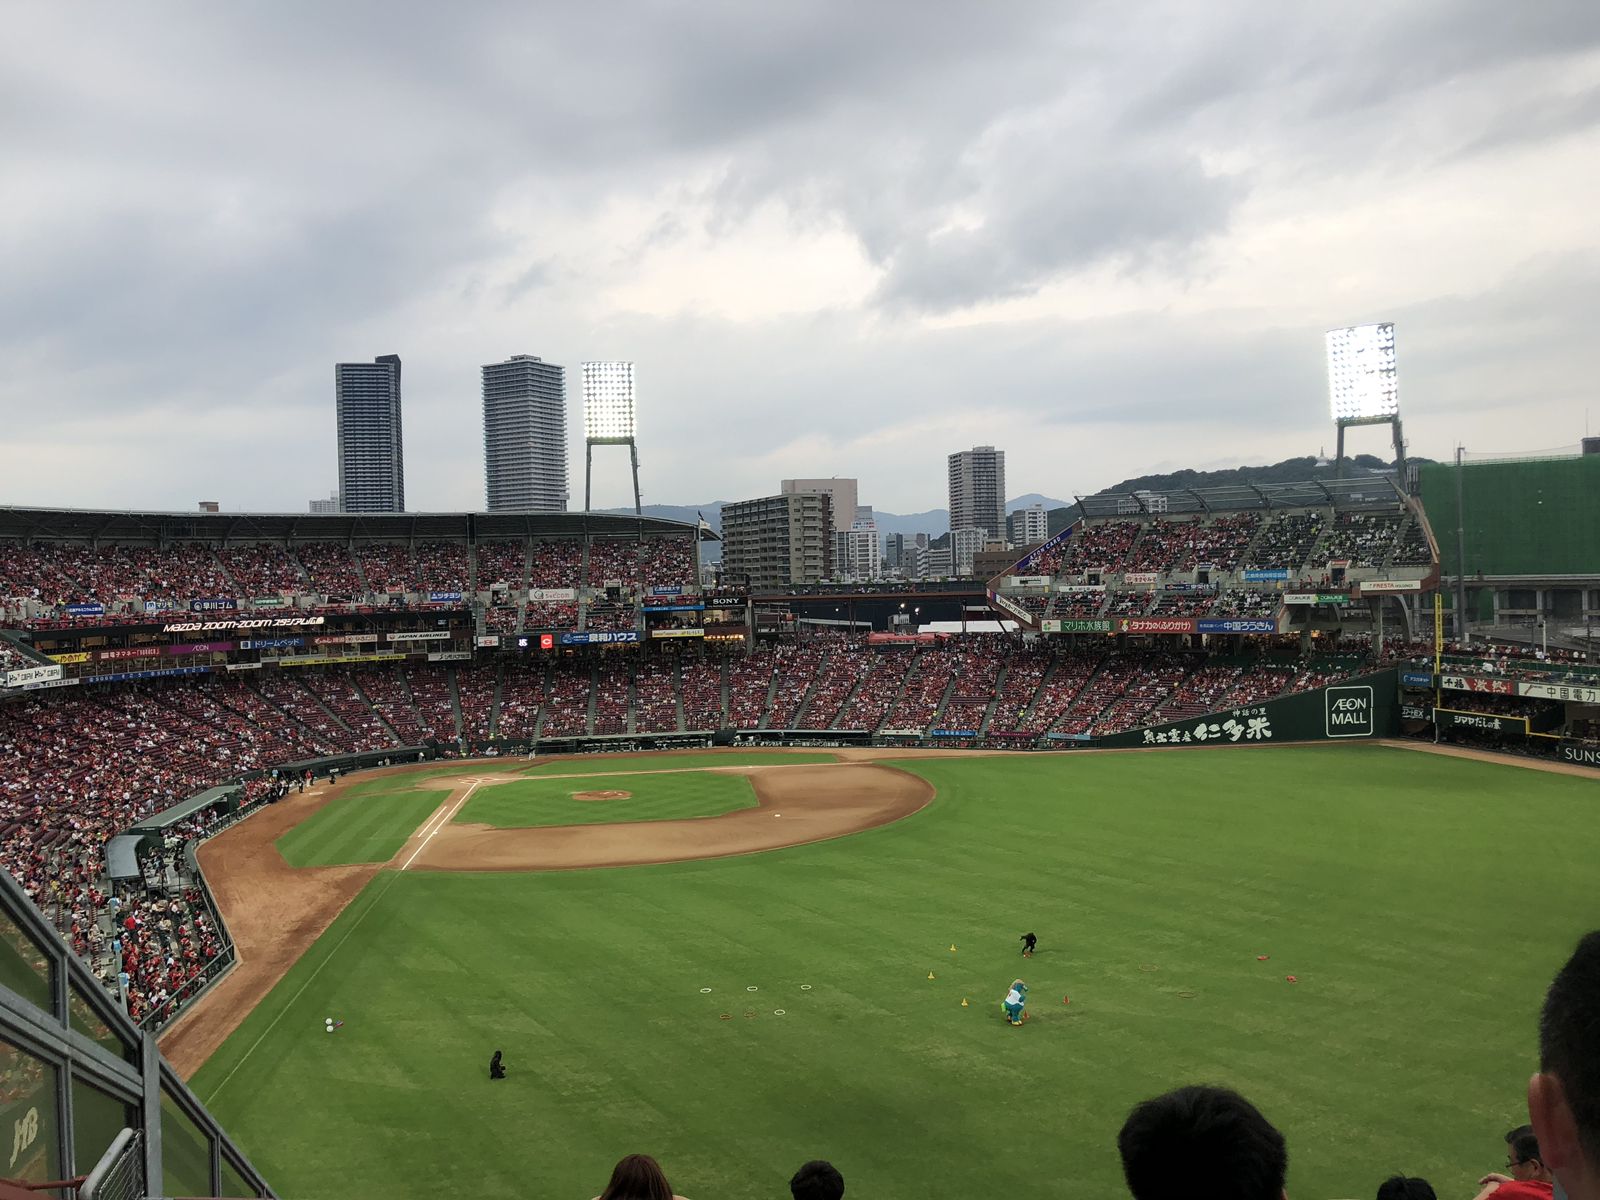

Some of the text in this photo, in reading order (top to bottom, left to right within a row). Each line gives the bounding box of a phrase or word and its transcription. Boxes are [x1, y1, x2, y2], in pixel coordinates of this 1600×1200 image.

[203, 601, 233, 610] 早川ゴム
[1063, 621, 1110, 631] マリホ水族館
[1223, 621, 1274, 631] 中国ろうきん
[588, 632, 637, 643] 良和ハウス
[255, 638, 300, 648] ドリームベッド
[1546, 686, 1596, 702] 中国電力
[1232, 707, 1267, 717] 神話の里
[1331, 712, 1367, 725] MALL
[1454, 715, 1502, 730] シマヤだしの素
